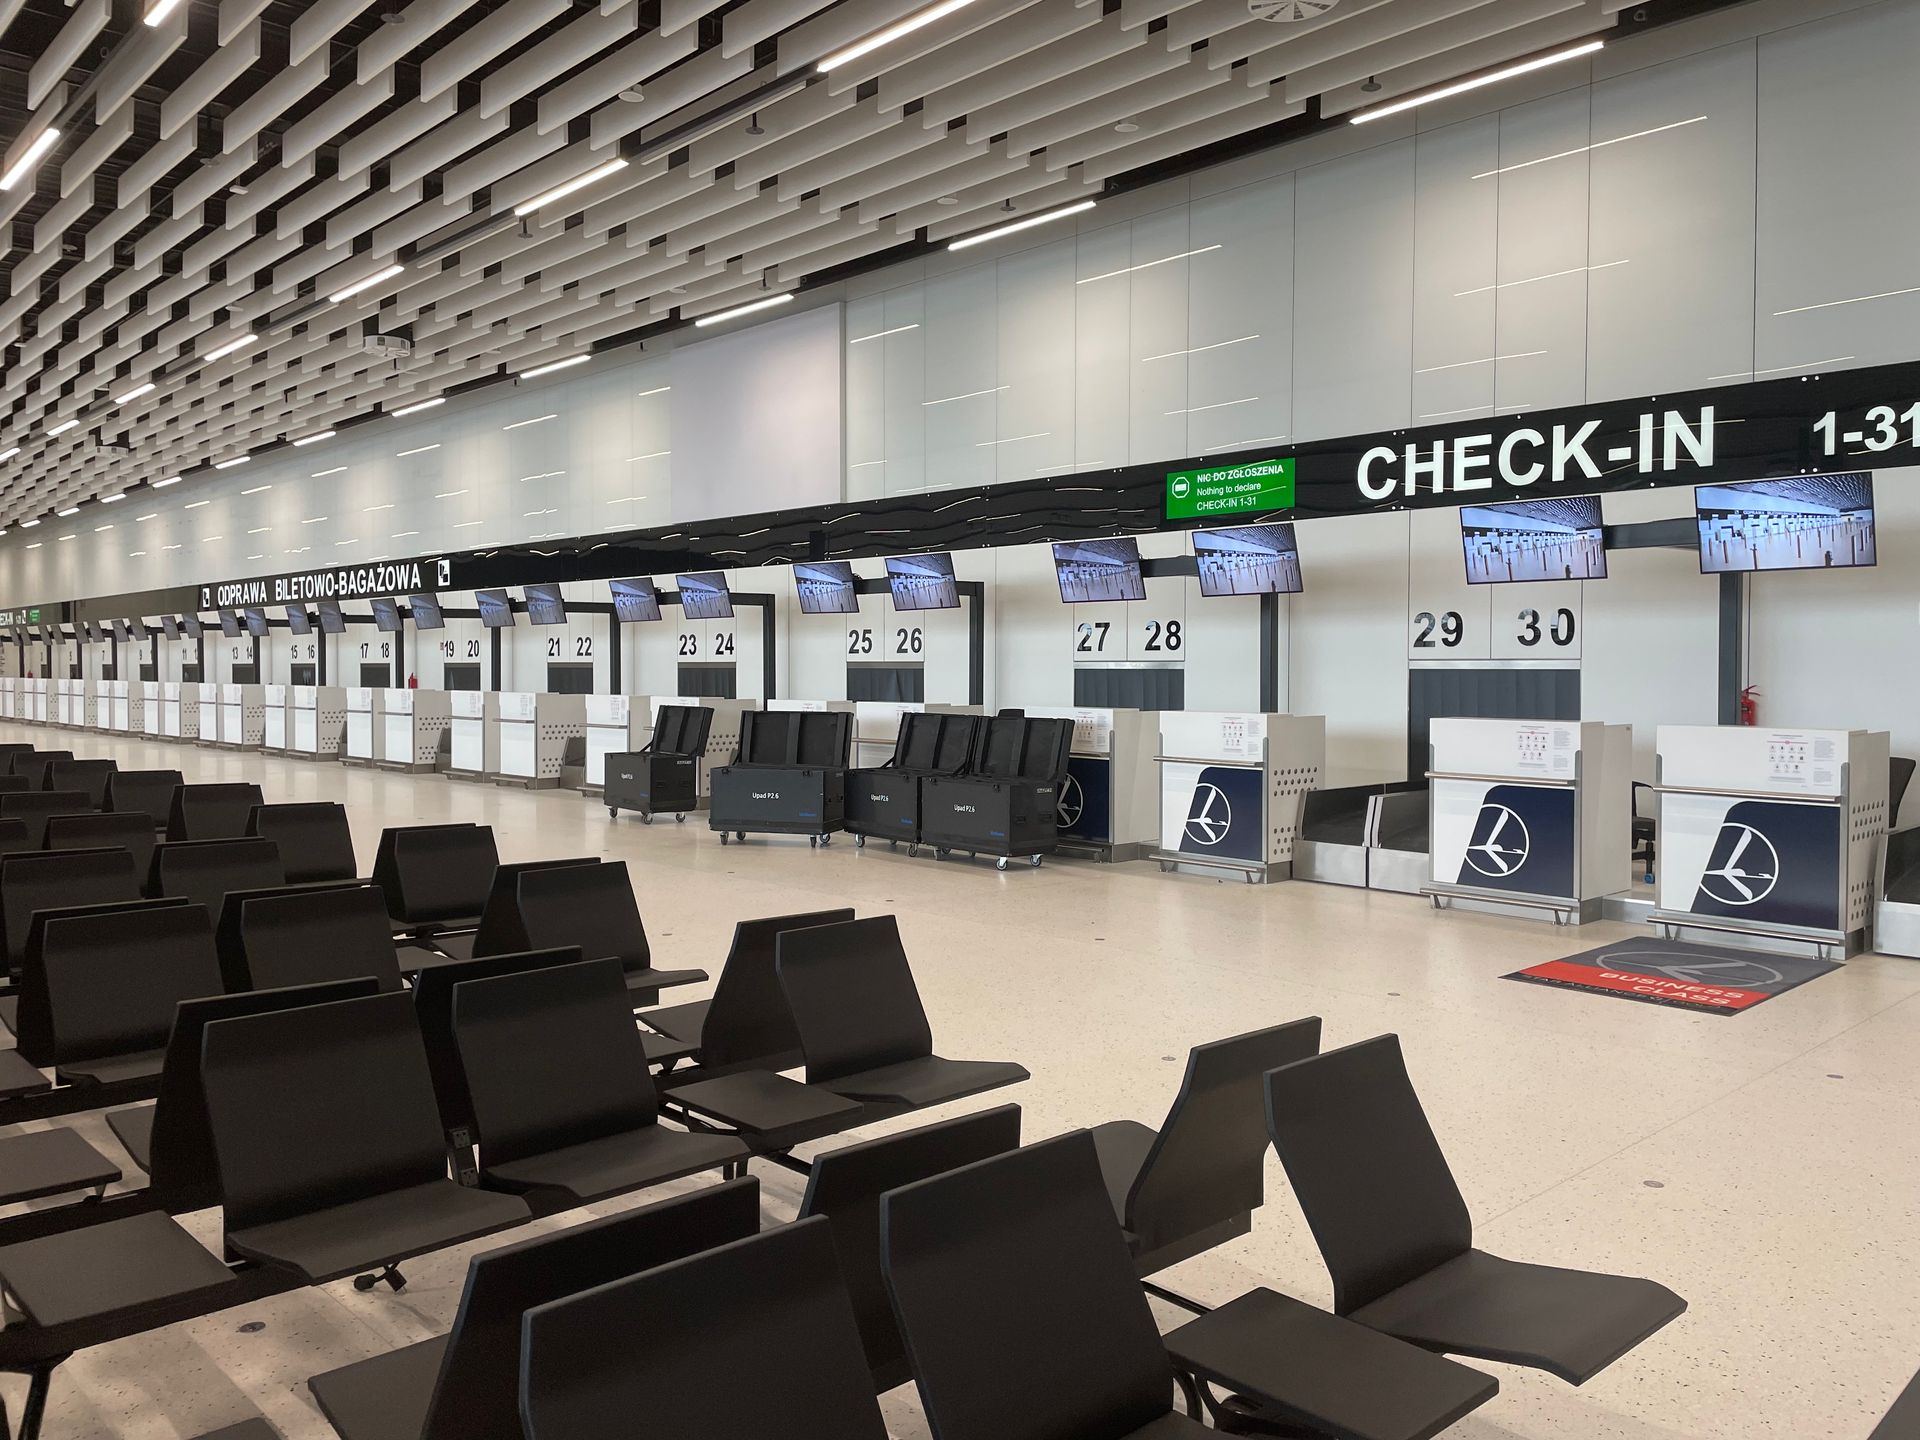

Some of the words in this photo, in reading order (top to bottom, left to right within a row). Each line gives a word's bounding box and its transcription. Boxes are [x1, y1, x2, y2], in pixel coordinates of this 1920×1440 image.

[1357, 406, 1714, 500] CHECK-IN
[1813, 401, 1920, 456] 1-31
[1197, 473, 1212, 483] NIC
[1213, 471, 1226, 481] DO
[1227, 464, 1284, 480] ZGŁOSZENIA
[1197, 485, 1224, 496] Nothing
[1225, 485, 1233, 493] to
[1234, 482, 1262, 492] declare
[1197, 498, 1238, 511] CHECK-IN
[1240, 496, 1257, 507] 1-31
[217, 581, 268, 606] ODPRAWA
[275, 562, 422, 601] BILETOWO-BAGAŻOWA
[1077, 621, 1111, 652] 27
[1144, 620, 1183, 652] 28
[1413, 611, 1464, 648] 29
[1517, 608, 1576, 647] 30
[360, 642, 369, 659] 17
[380, 642, 390, 658] 18
[444, 640, 455, 658] 19
[467, 639, 480, 658] 20
[548, 637, 561, 657] 21
[576, 636, 593, 657] 22
[679, 634, 698, 656] 23
[715, 632, 735, 656] 24
[848, 628, 873, 655] 25
[896, 627, 923, 654] 26
[232, 646, 239, 660] 13
[290, 644, 298, 660] 15
[307, 643, 315, 659] 16
[752, 792, 767, 801] Upad
[767, 792, 780, 800] P2.6
[953, 803, 966, 812] Upad
[1599, 972, 1745, 999] BUSINESS
[1632, 985, 1731, 1005] CLASS
